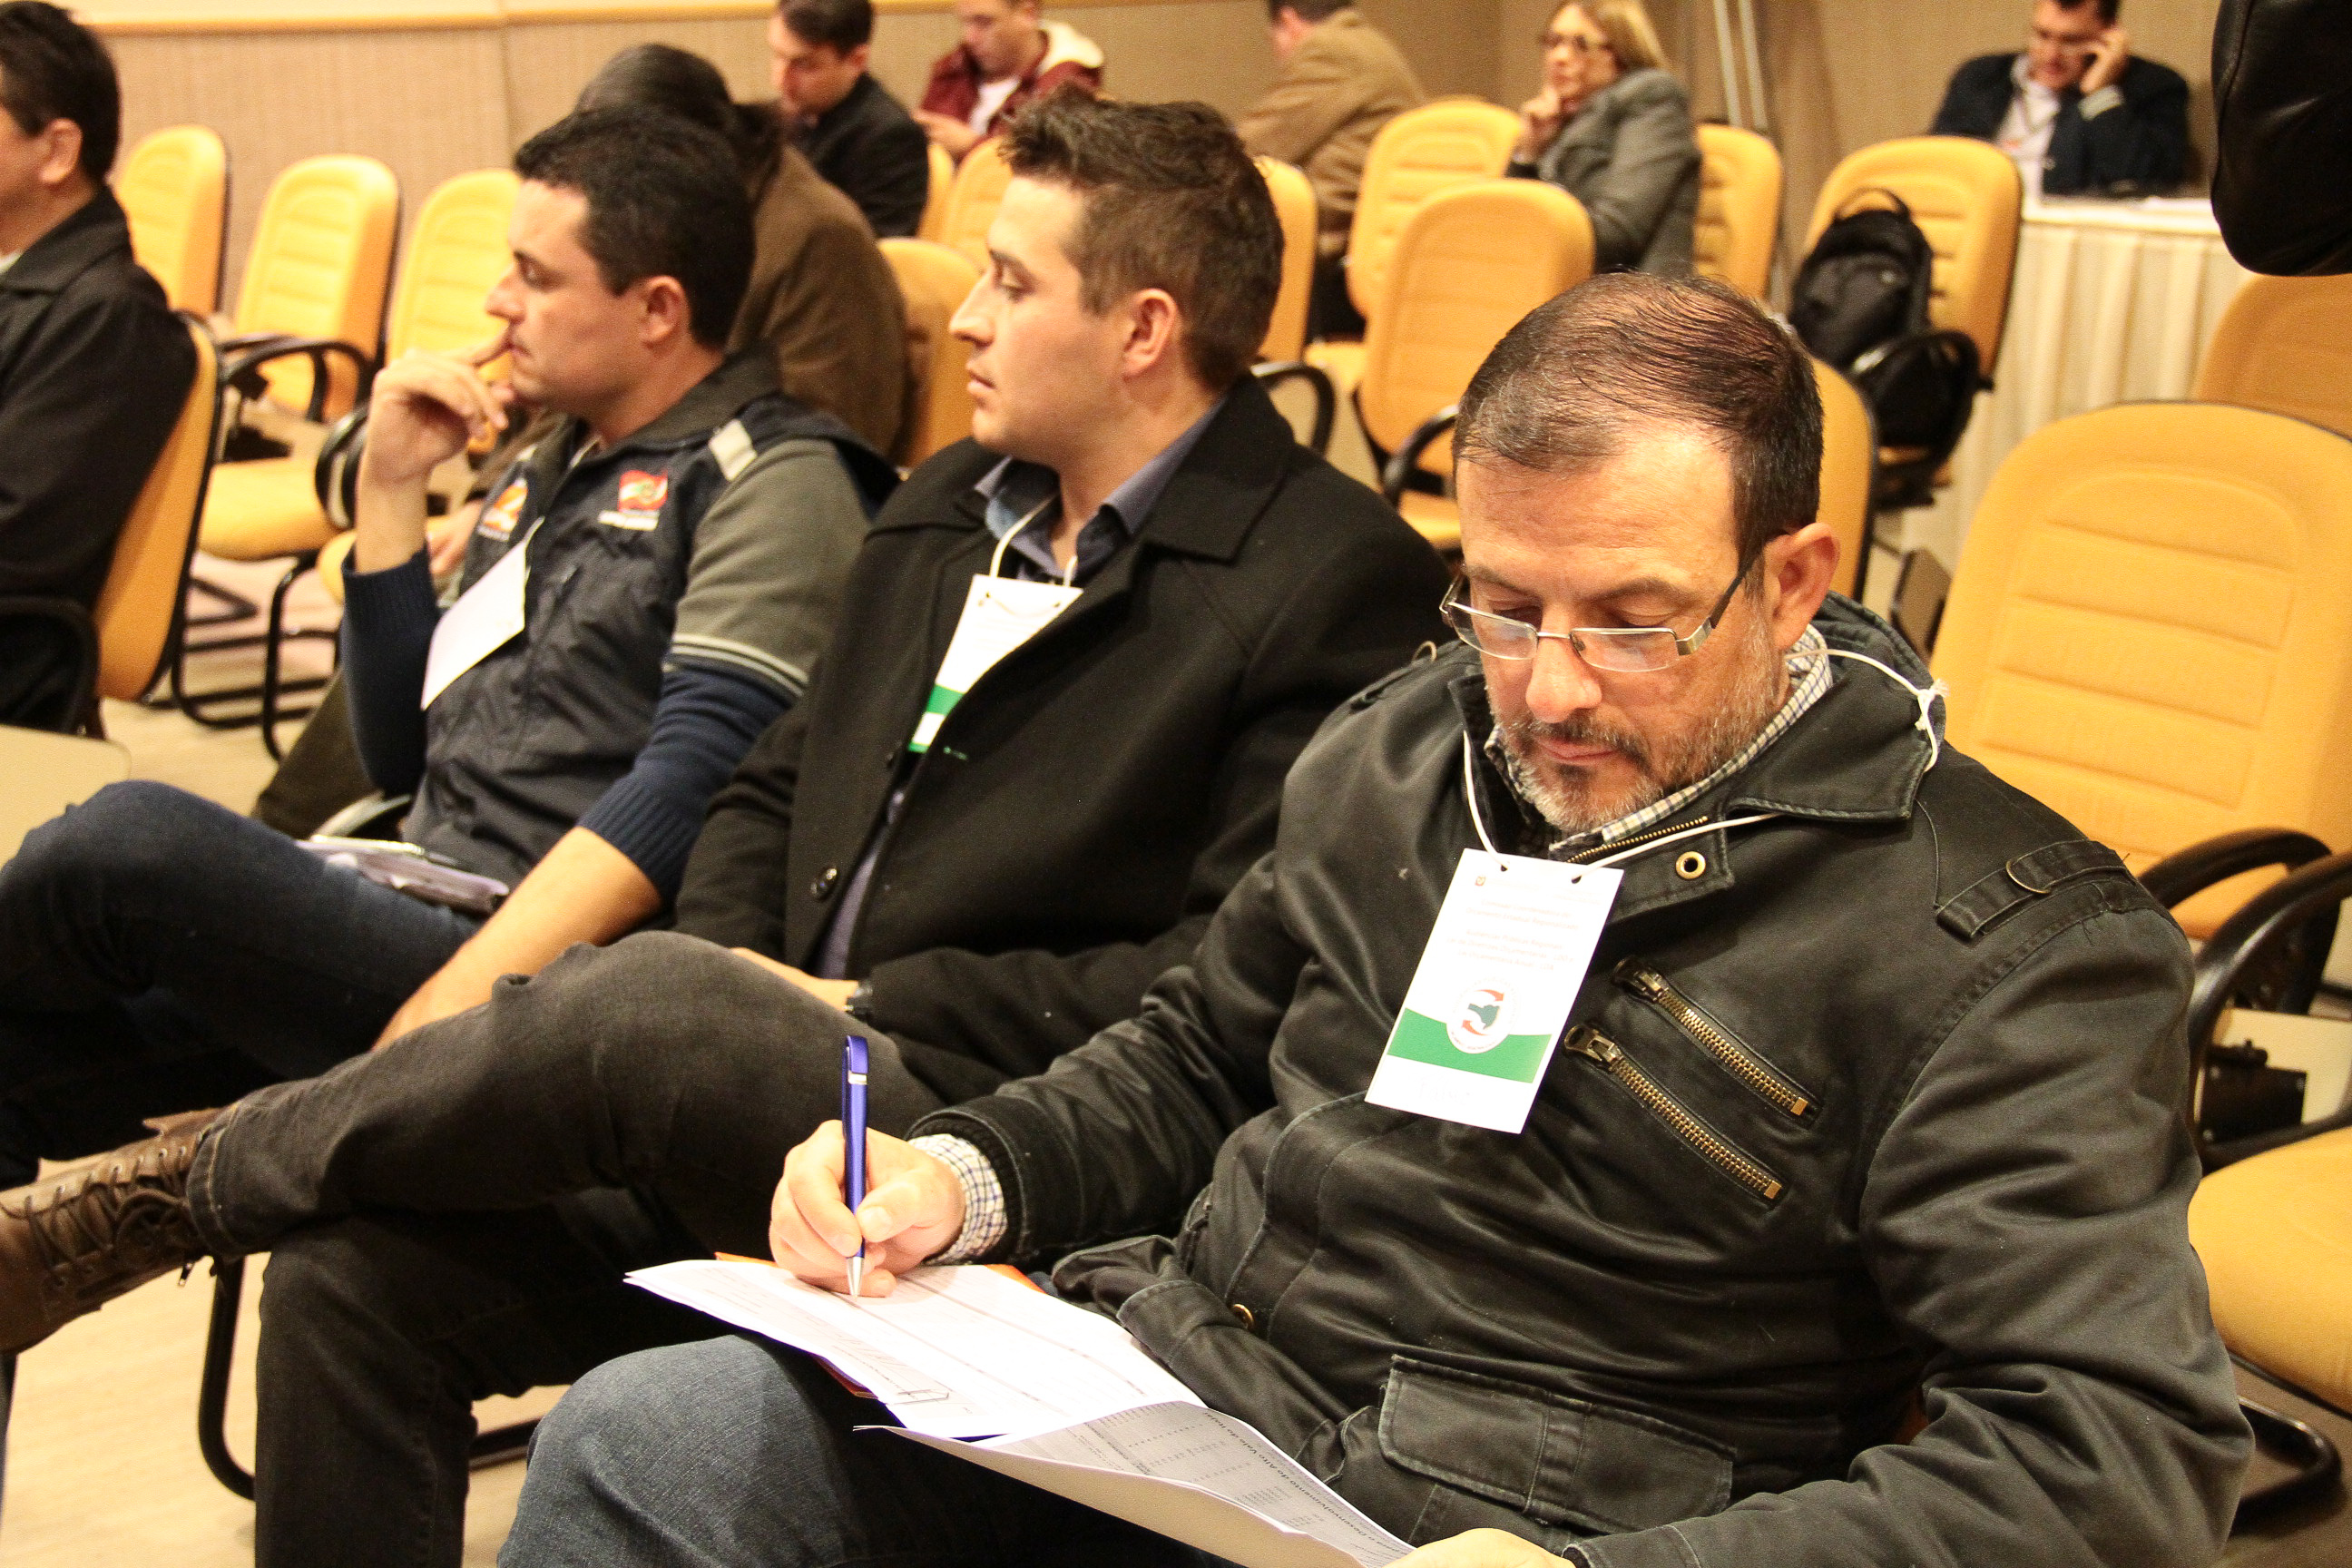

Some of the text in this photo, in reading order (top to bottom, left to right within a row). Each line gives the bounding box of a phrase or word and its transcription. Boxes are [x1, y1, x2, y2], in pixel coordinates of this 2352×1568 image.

[1240, 1439, 1258, 1455] Vale
[1259, 1455, 1278, 1469] Alto
[1278, 1469, 1289, 1480] do
[1290, 1480, 1367, 1536] Desenvolvimento
